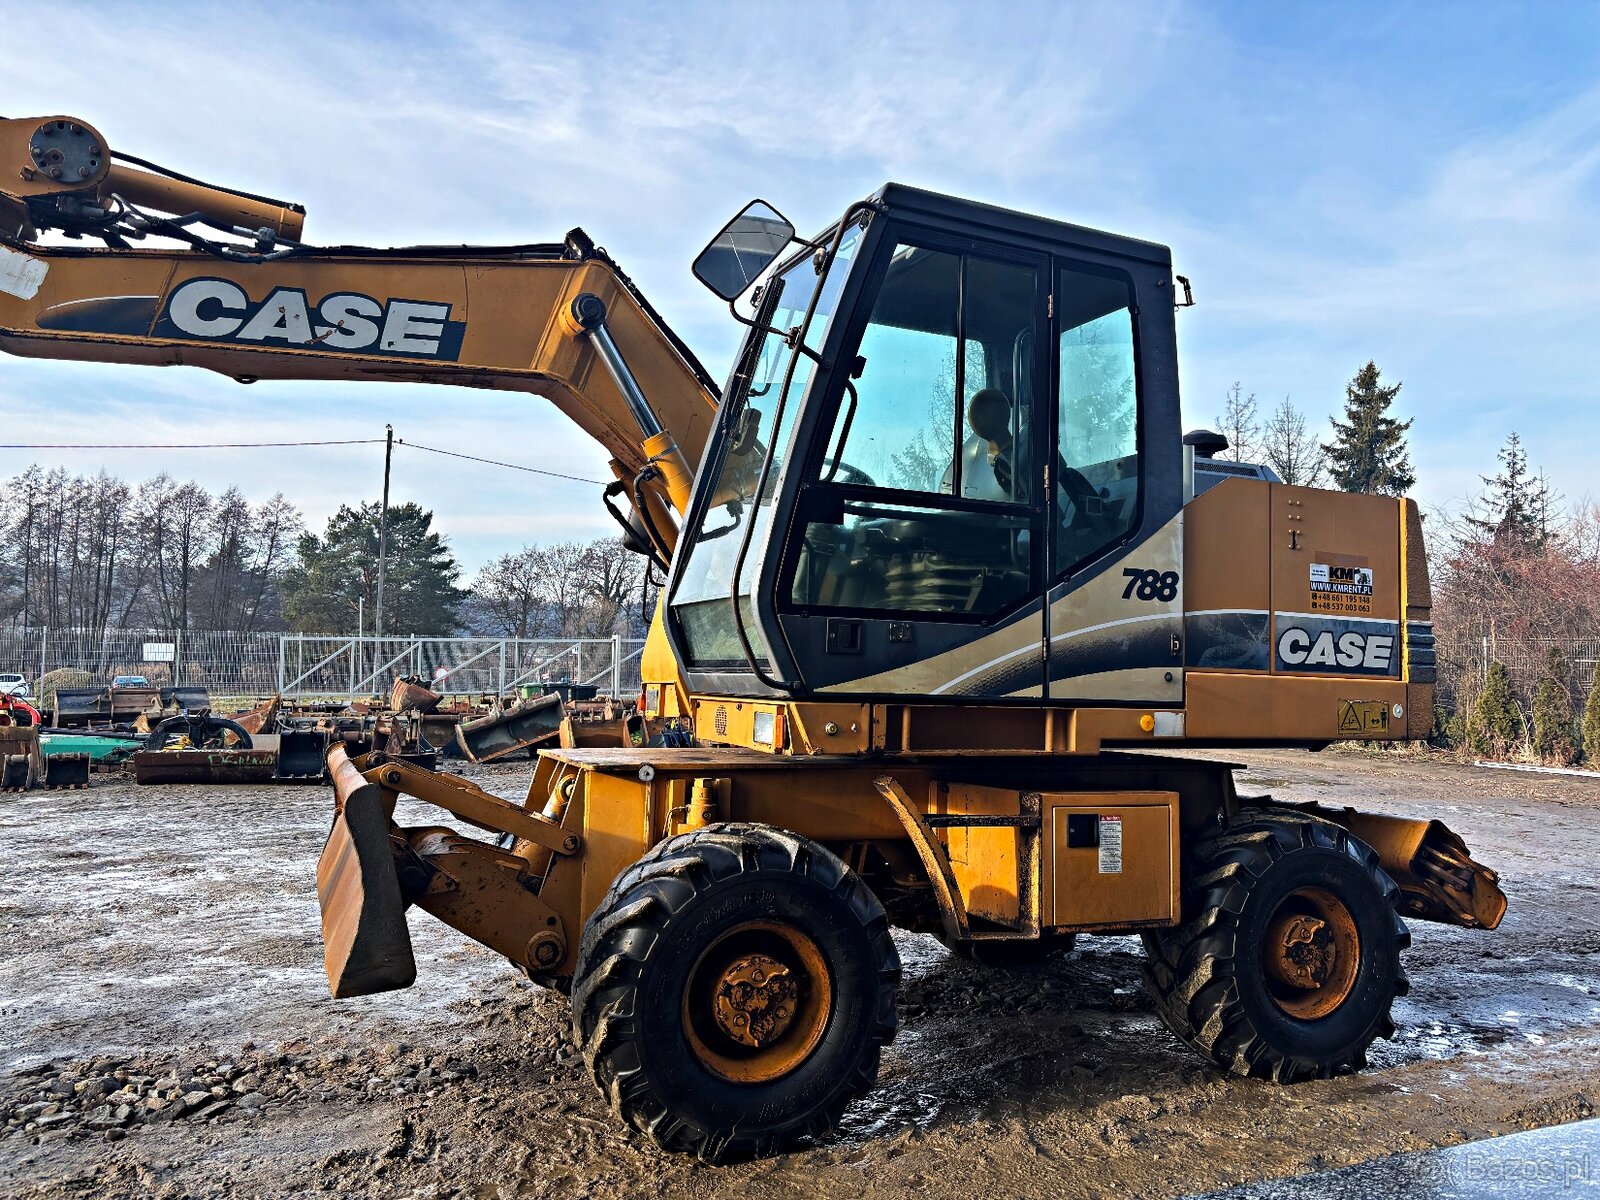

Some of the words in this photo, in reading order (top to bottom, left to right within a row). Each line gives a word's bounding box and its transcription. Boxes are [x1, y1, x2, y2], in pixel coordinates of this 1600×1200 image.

[168, 279, 451, 355] CASE
[1122, 567, 1180, 603] 788
[1310, 581, 1372, 595] WWW.KMRENT.PL
[1329, 566, 1353, 580] KM
[1278, 628, 1394, 669] CASE
